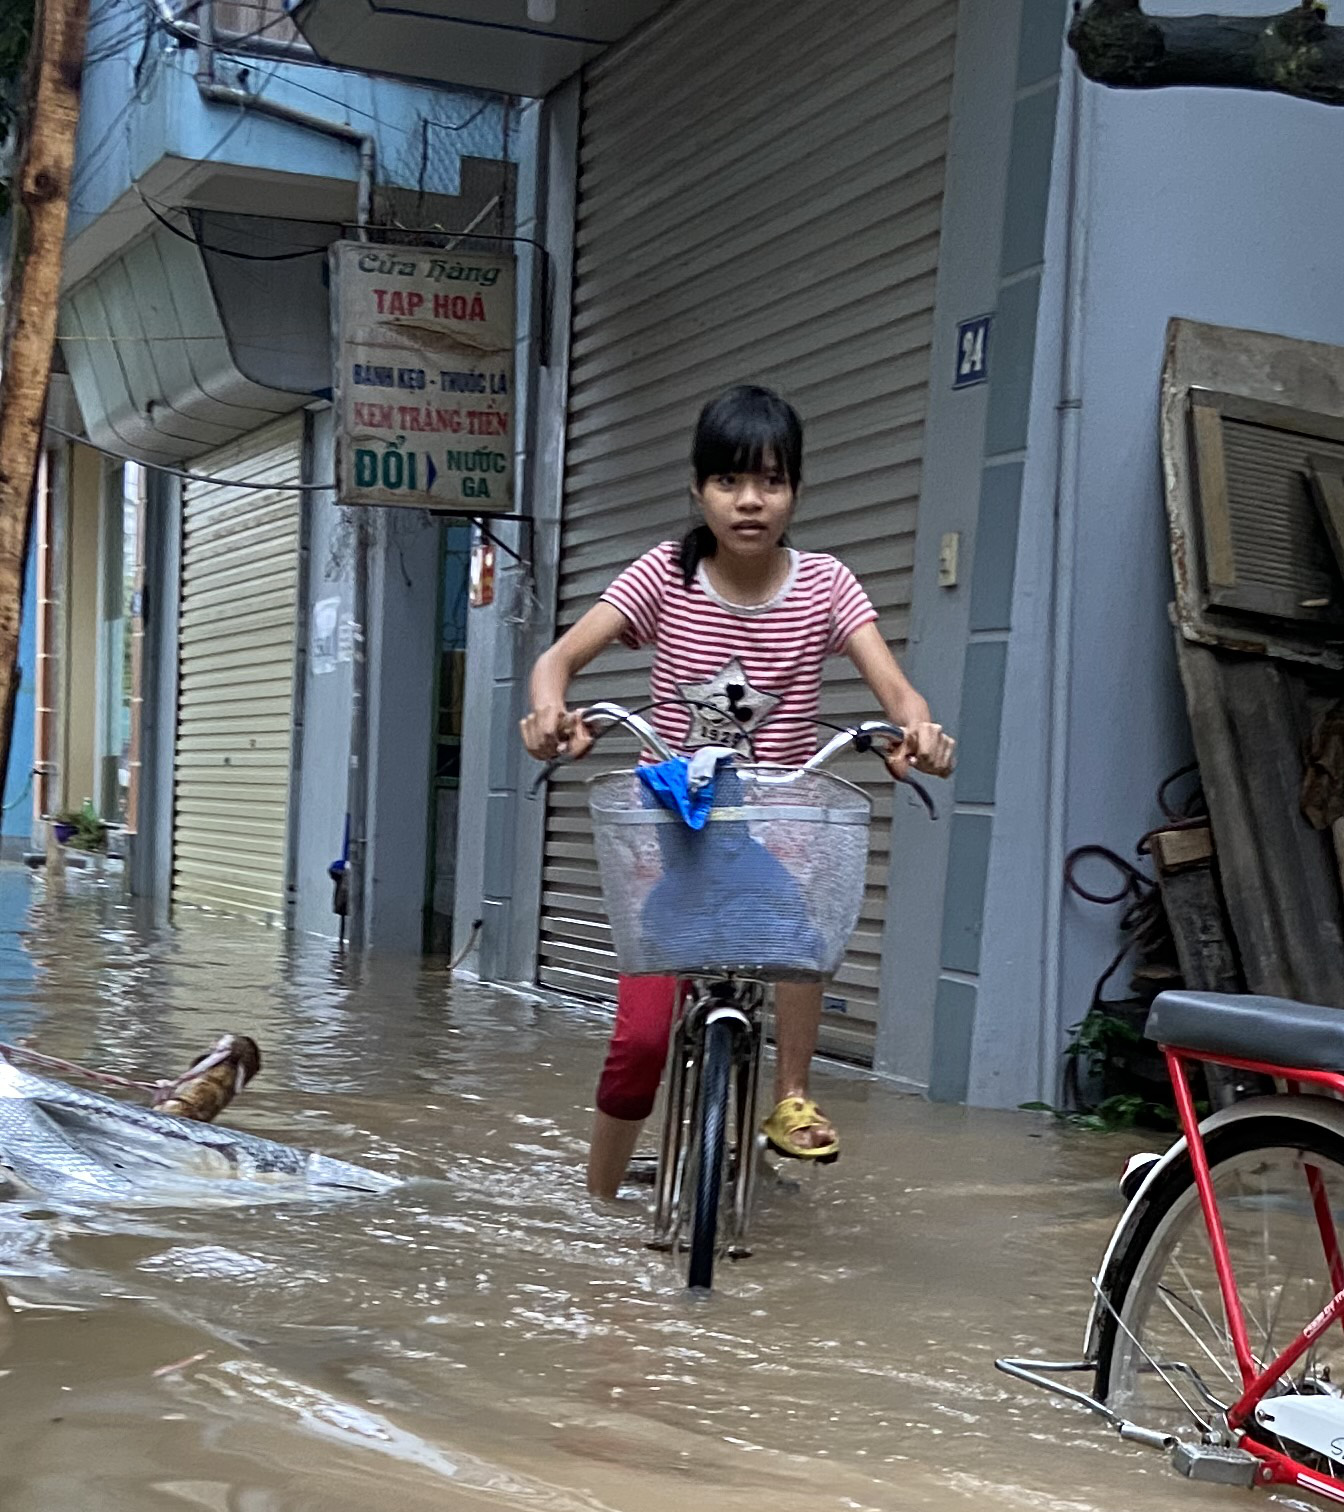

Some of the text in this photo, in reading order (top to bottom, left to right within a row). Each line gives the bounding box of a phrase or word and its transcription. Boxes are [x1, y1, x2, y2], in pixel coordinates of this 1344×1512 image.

[358, 252, 416, 277] Cửa
[432, 291, 487, 322] HOÁ
[353, 360, 394, 388] BÁNH
[397, 367, 426, 394] KẸO
[353, 401, 394, 429] KEM
[354, 434, 507, 491] ĐỔI NƯỚC
[462, 476, 492, 499] GA
